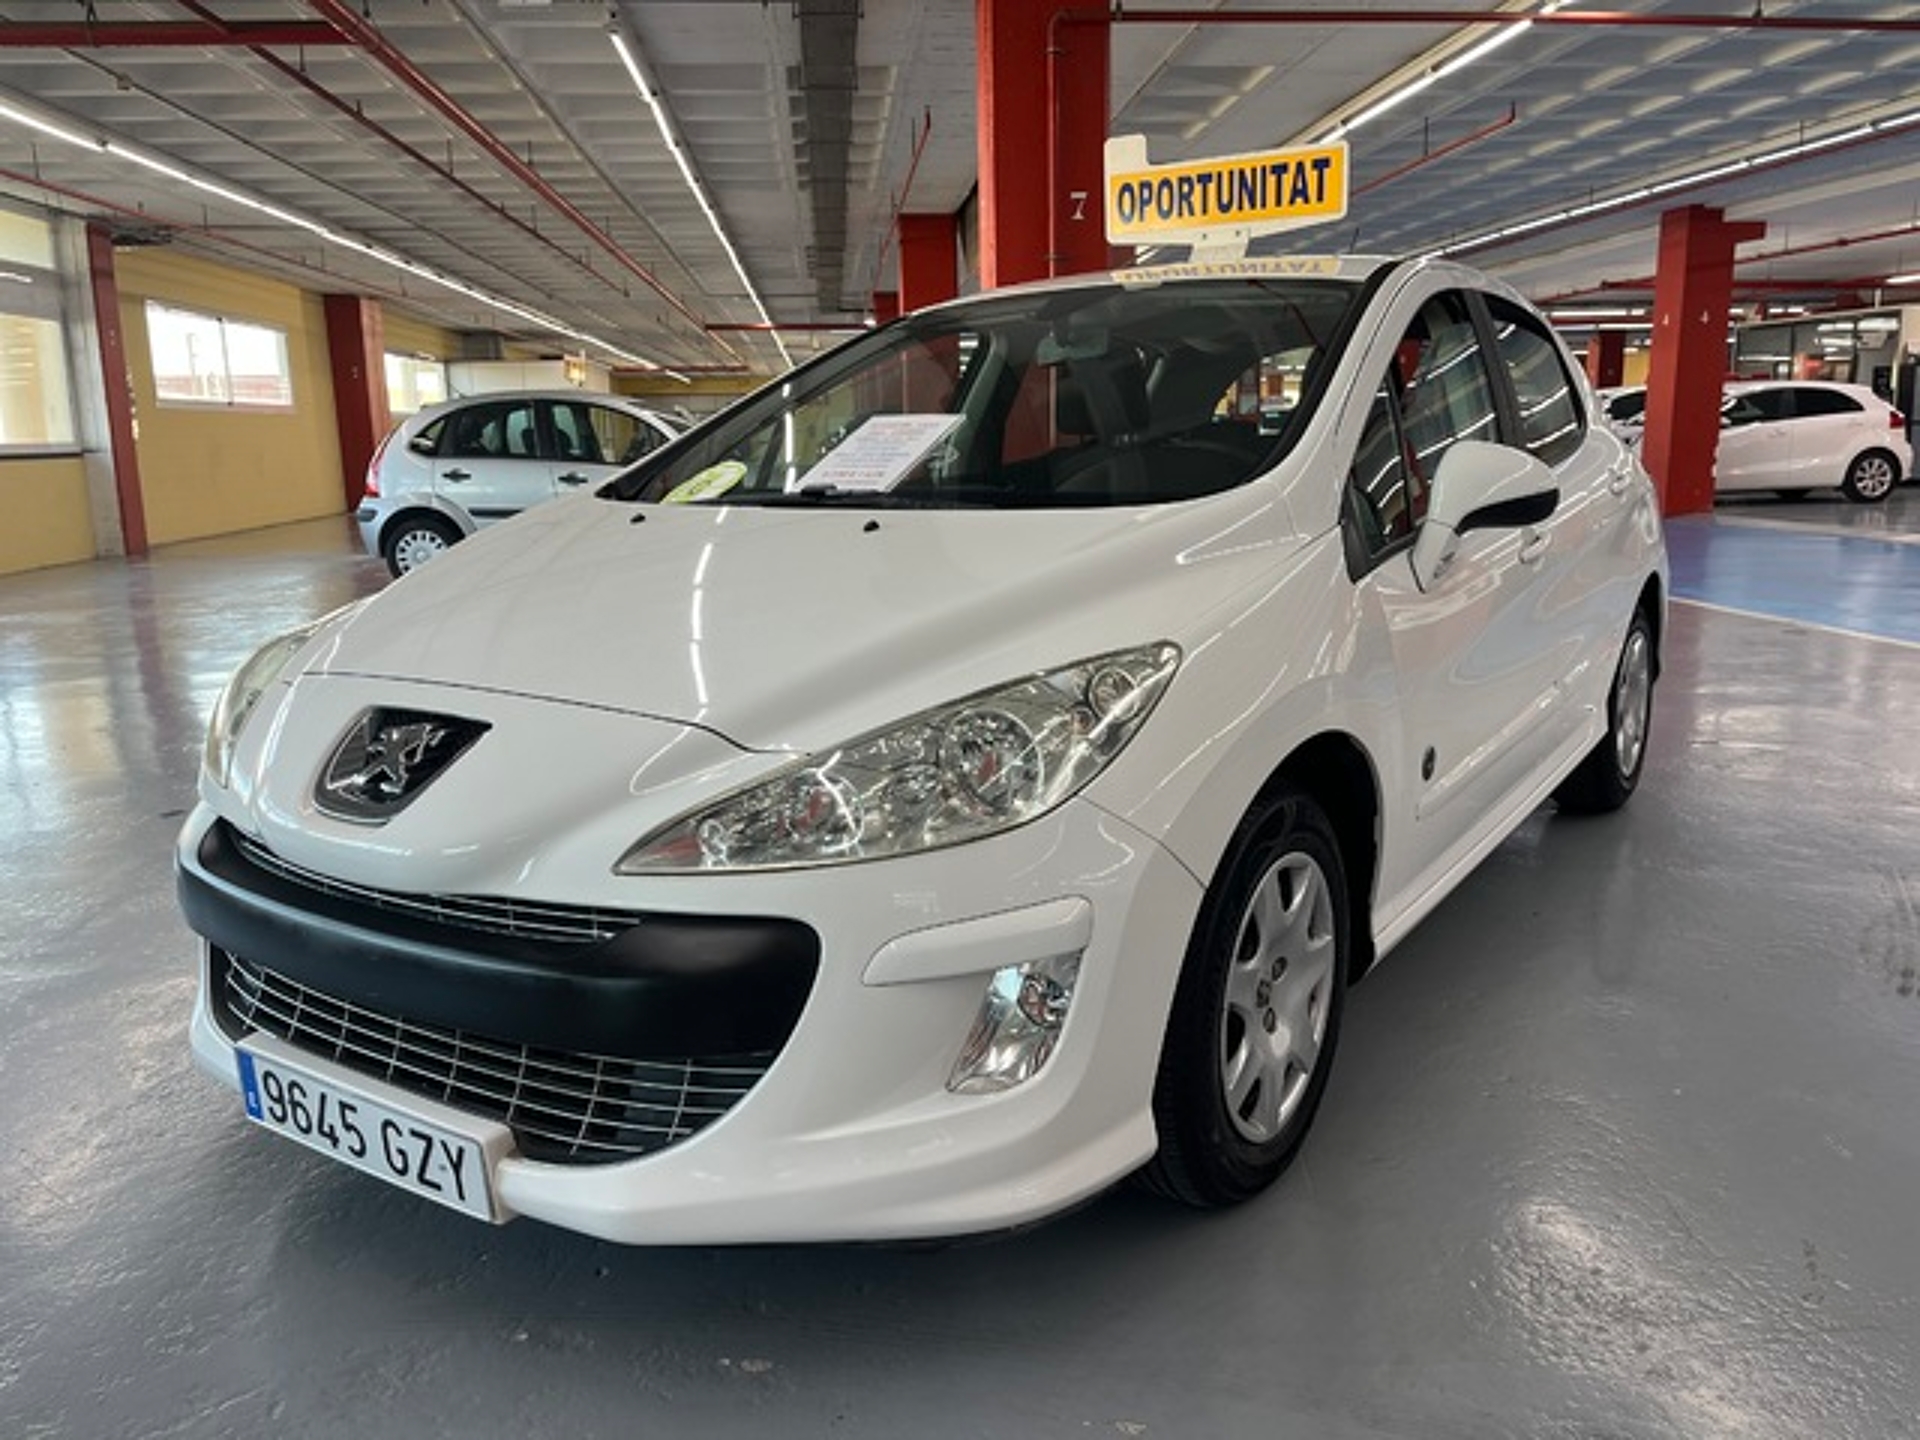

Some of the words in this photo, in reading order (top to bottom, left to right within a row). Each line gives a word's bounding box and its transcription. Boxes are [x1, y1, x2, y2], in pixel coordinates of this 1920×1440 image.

[1070, 191, 1087, 220] 7
[1117, 157, 1331, 224] OPORTUNITAT
[262, 1070, 367, 1159] 9645
[380, 1118, 466, 1201] GZY
